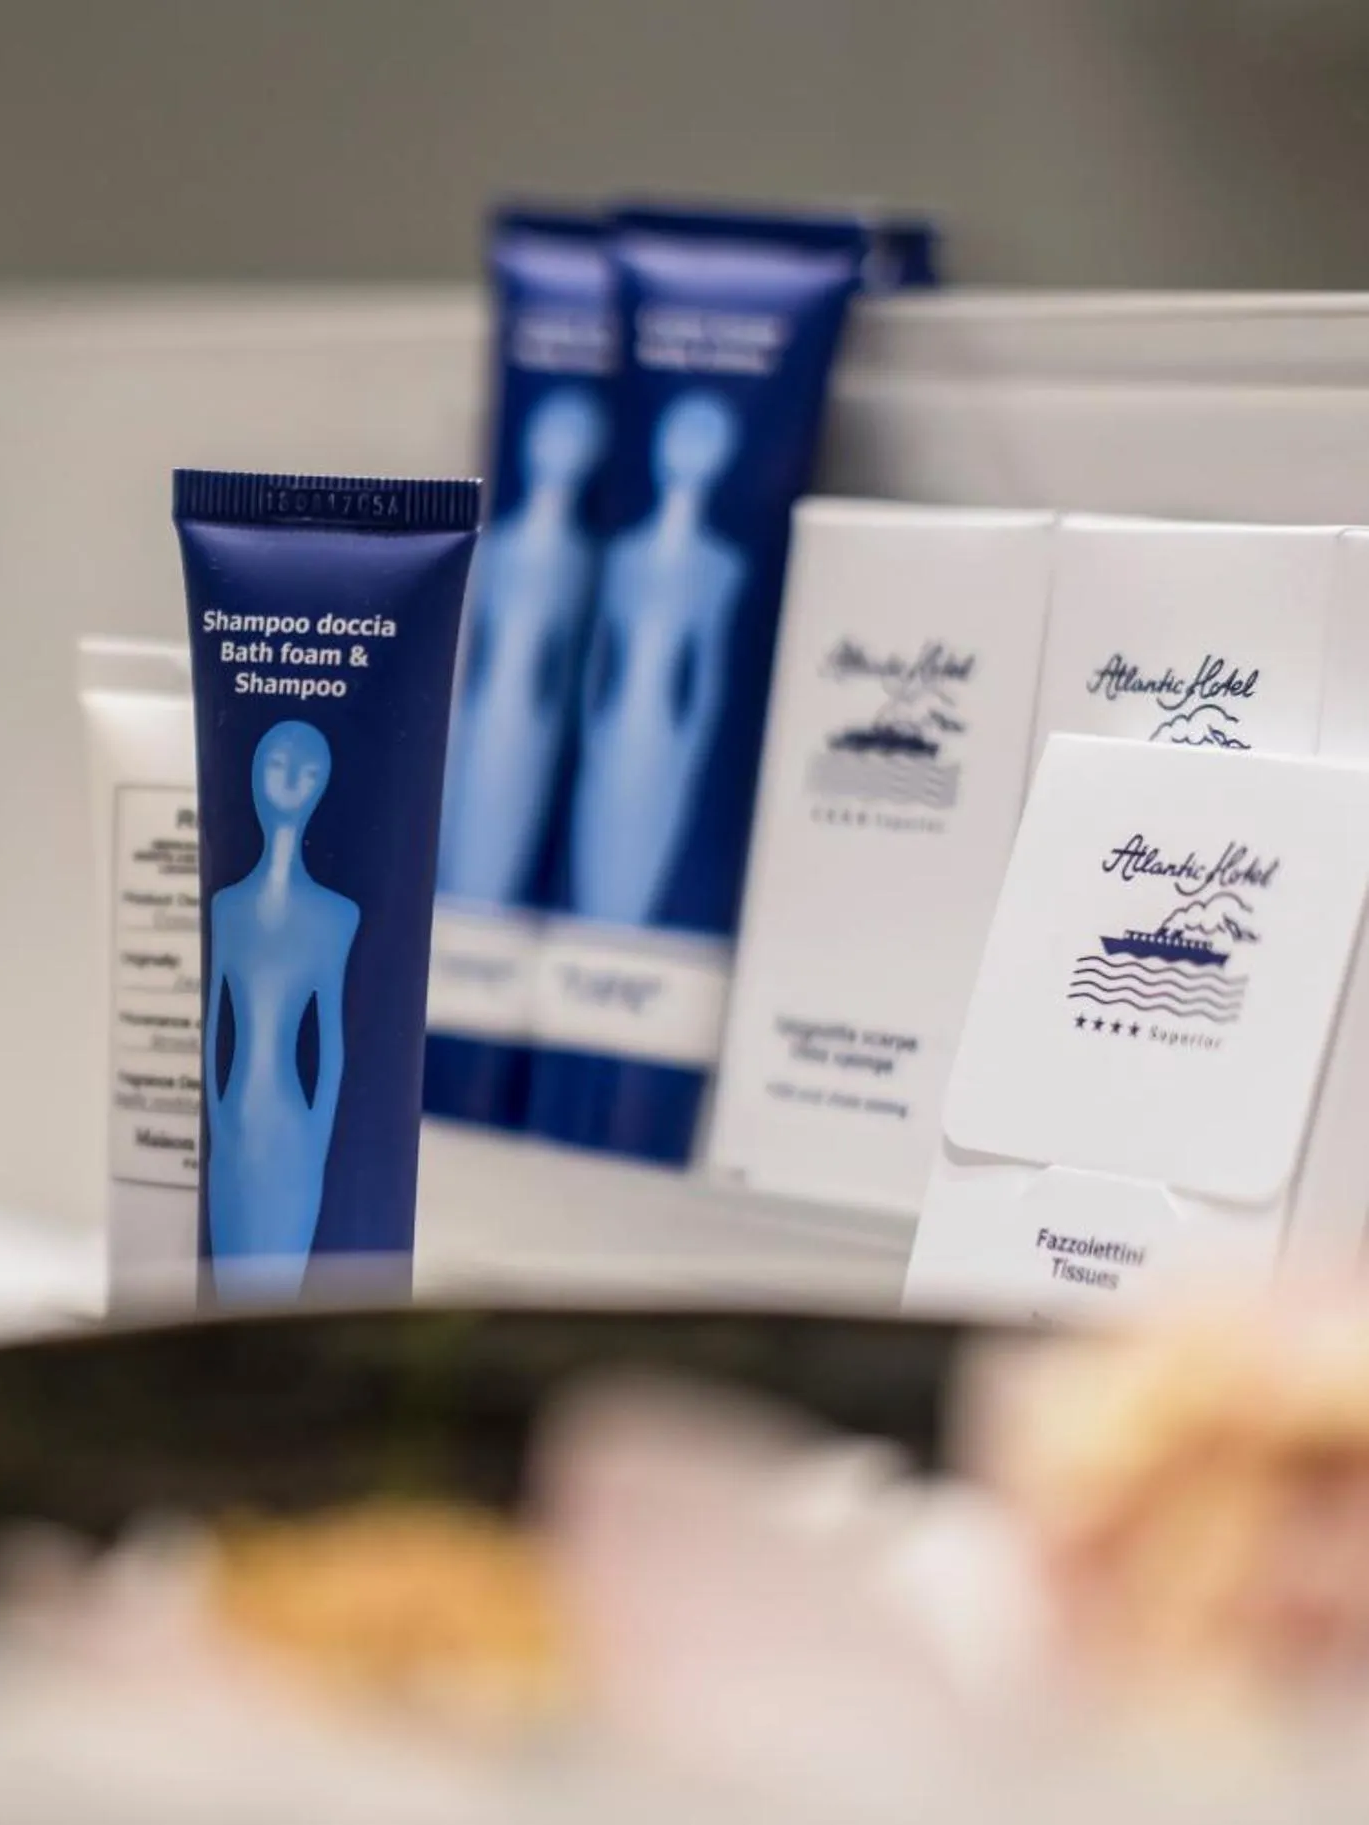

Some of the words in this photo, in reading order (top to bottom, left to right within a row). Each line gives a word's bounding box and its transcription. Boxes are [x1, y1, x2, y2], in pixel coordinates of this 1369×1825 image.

[202, 610, 310, 637] Shampoo
[316, 613, 398, 638] doccia
[220, 641, 274, 664] Bath
[281, 642, 341, 667] foam
[349, 645, 370, 668] &
[234, 672, 348, 699] Shampoo
[1086, 652, 1184, 701] Atlantic
[1157, 653, 1260, 711] Hotel
[1101, 833, 1205, 882] Atlantic
[1176, 840, 1280, 896] Hotel
[1148, 1025, 1224, 1050] Superior
[1034, 1226, 1148, 1267] Fazzolettini
[1051, 1256, 1121, 1291] Tissues
